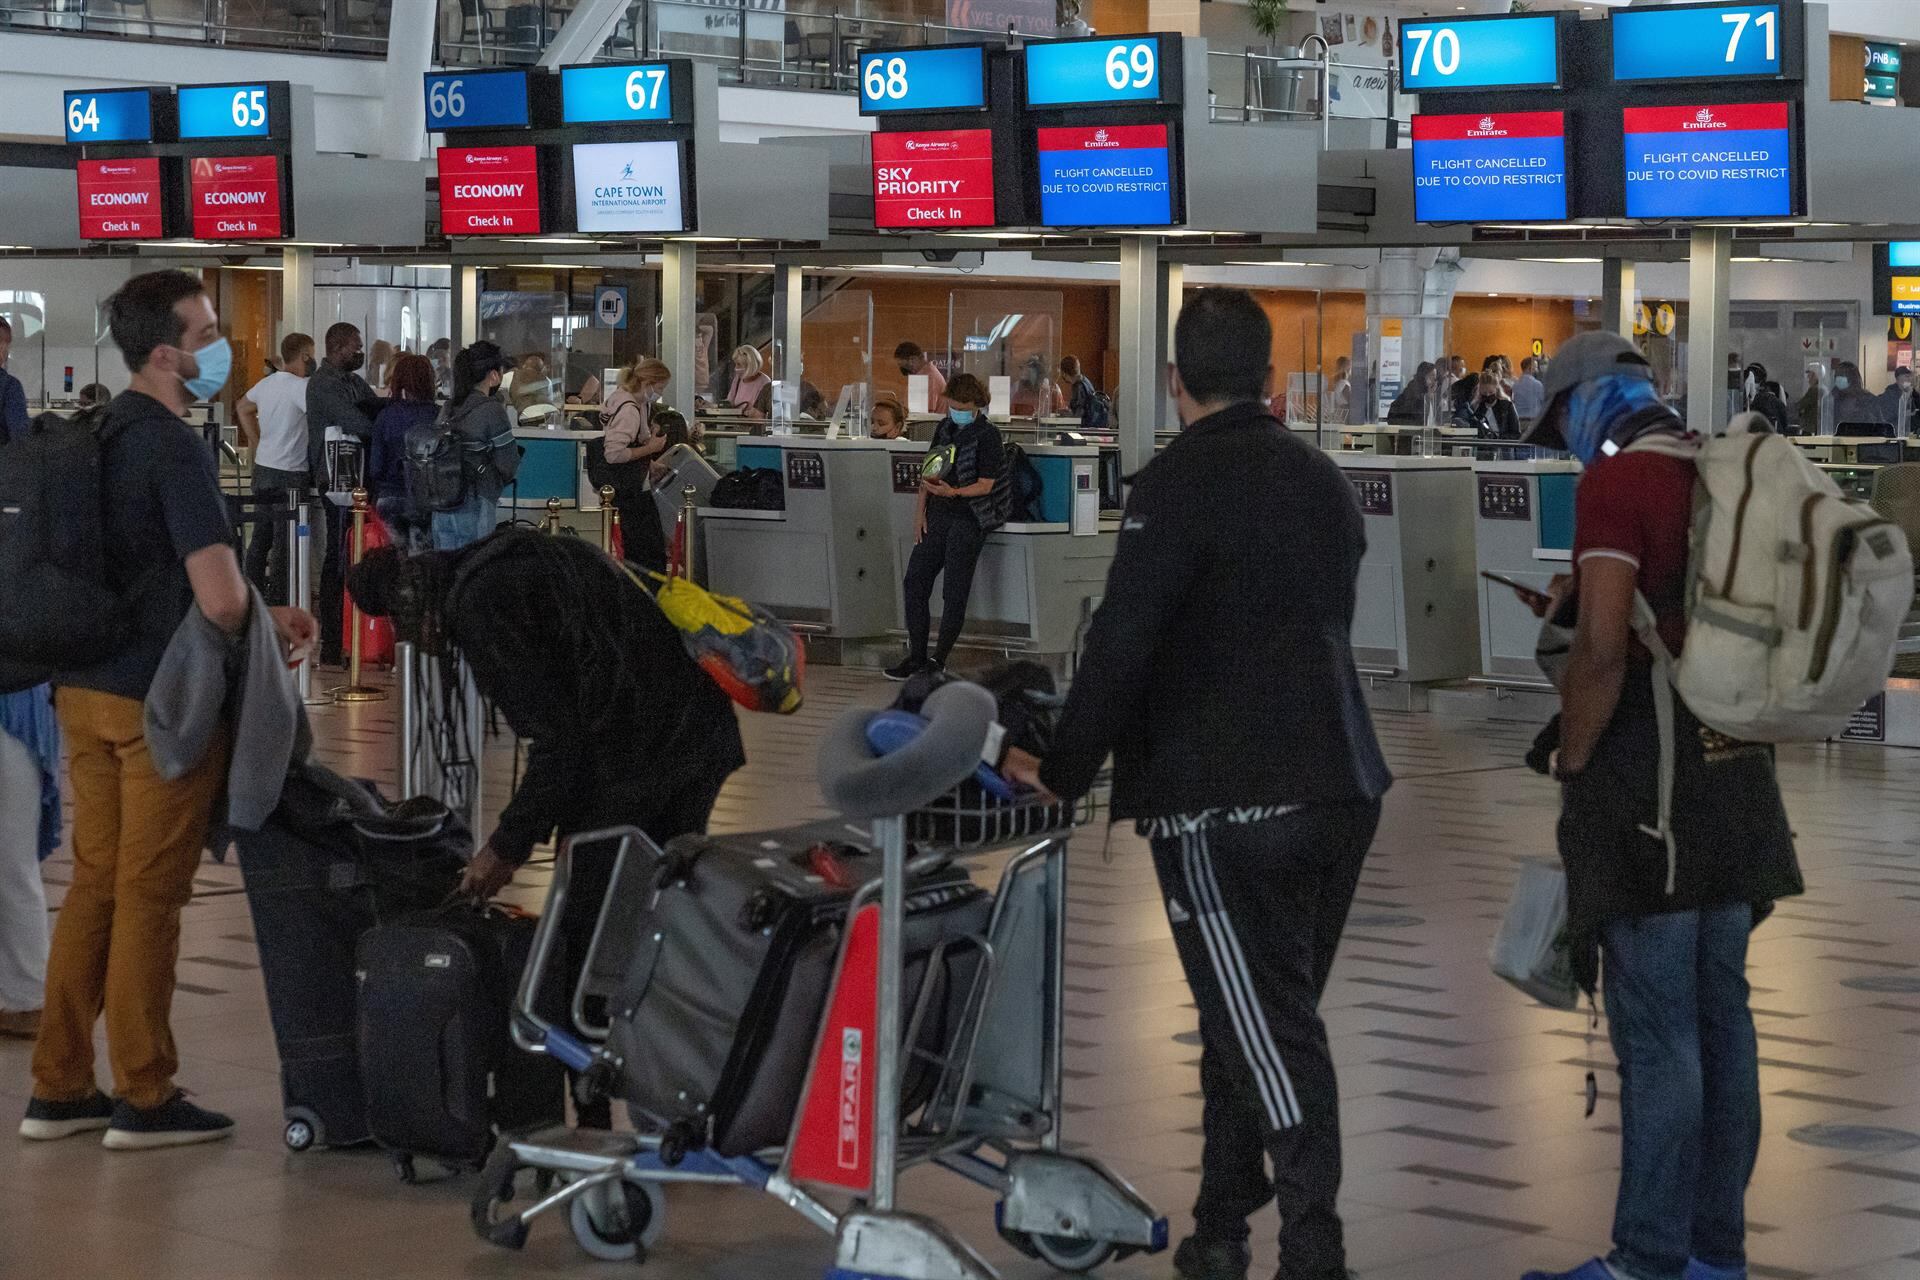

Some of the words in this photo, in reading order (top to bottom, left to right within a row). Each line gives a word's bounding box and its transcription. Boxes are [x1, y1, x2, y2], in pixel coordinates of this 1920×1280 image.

[1721, 12, 1775, 62] 71
[1406, 28, 1460, 76] 70
[1872, 52, 1888, 64] FNB
[1105, 44, 1154, 90] 69
[864, 58, 908, 100] 68
[1364, 74, 1387, 90] new
[625, 70, 666, 110] 67
[429, 80, 466, 118] 66
[232, 90, 265, 128] 65
[68, 98, 100, 134] 64
[1682, 120, 1726, 130] Emirates
[1467, 128, 1508, 136] Emirates
[1084, 140, 1120, 148] Emirates
[1431, 159, 1472, 169] FLIGHT
[1475, 158, 1546, 168] CANCELLED
[1643, 153, 1689, 164] FLIGHT
[1692, 150, 1769, 162] CANCELLED
[878, 168, 912, 181] SKY
[1054, 168, 1089, 178] FLIGHT
[1092, 167, 1153, 177] CANCELLED
[1628, 170, 1654, 181] DUE
[1656, 170, 1675, 180] TO
[1678, 168, 1718, 180] COVID
[1722, 168, 1788, 179] RESTRICT
[1416, 176, 1440, 186] DUE
[1444, 176, 1460, 186] TO
[1462, 176, 1500, 185] COVID
[1503, 174, 1563, 184] RESTRICT
[454, 184, 524, 198] ECONOMY
[594, 187, 623, 198] CAPE
[626, 186, 663, 197] TOWN
[878, 180, 960, 195] PRIORITY
[1042, 184, 1063, 193] DUE
[1065, 184, 1080, 193] TO
[1082, 182, 1114, 192] COVID
[1116, 182, 1167, 192] RESTRICT
[90, 192, 149, 206] ECONOMY
[205, 192, 266, 205] ECONOMY
[642, 198, 666, 206] AIRPORT
[907, 208, 944, 220] Check
[950, 208, 962, 219] In
[102, 221, 128, 232] Check
[132, 222, 140, 231] In
[217, 221, 244, 232] Check
[248, 221, 257, 232] In
[468, 215, 500, 227] Check
[503, 216, 513, 226] In
